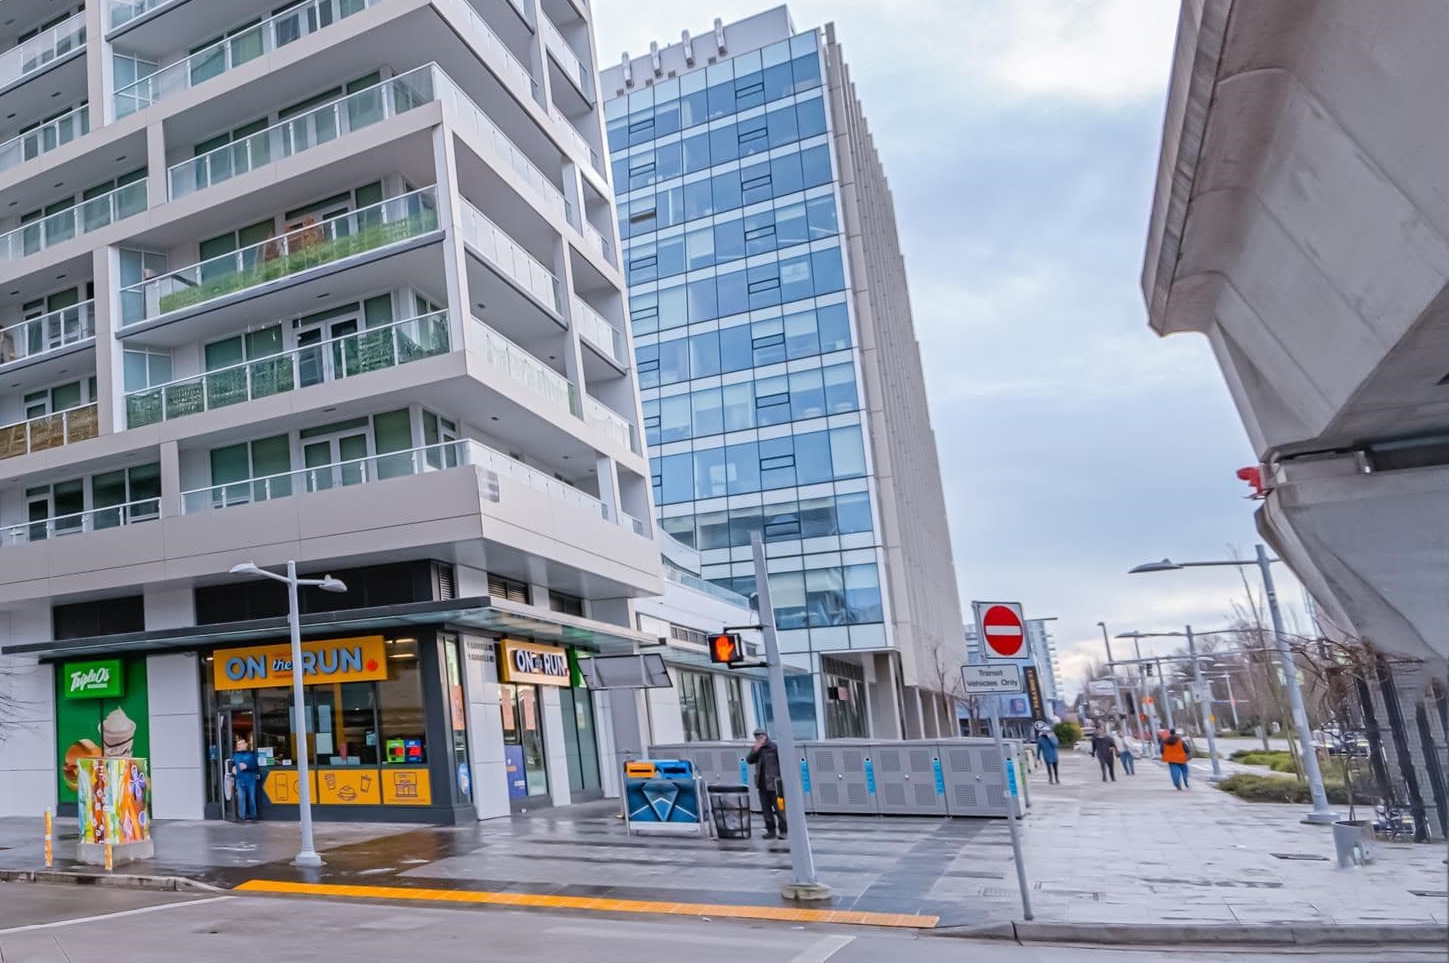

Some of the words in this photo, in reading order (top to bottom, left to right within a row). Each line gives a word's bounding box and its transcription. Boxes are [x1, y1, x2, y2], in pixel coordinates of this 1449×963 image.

[225, 654, 267, 681] ON
[272, 658, 292, 672] the
[301, 647, 362, 675] RUN
[516, 649, 535, 673] ON
[543, 652, 566, 676] RUN
[1000, 678, 1018, 687] Only
